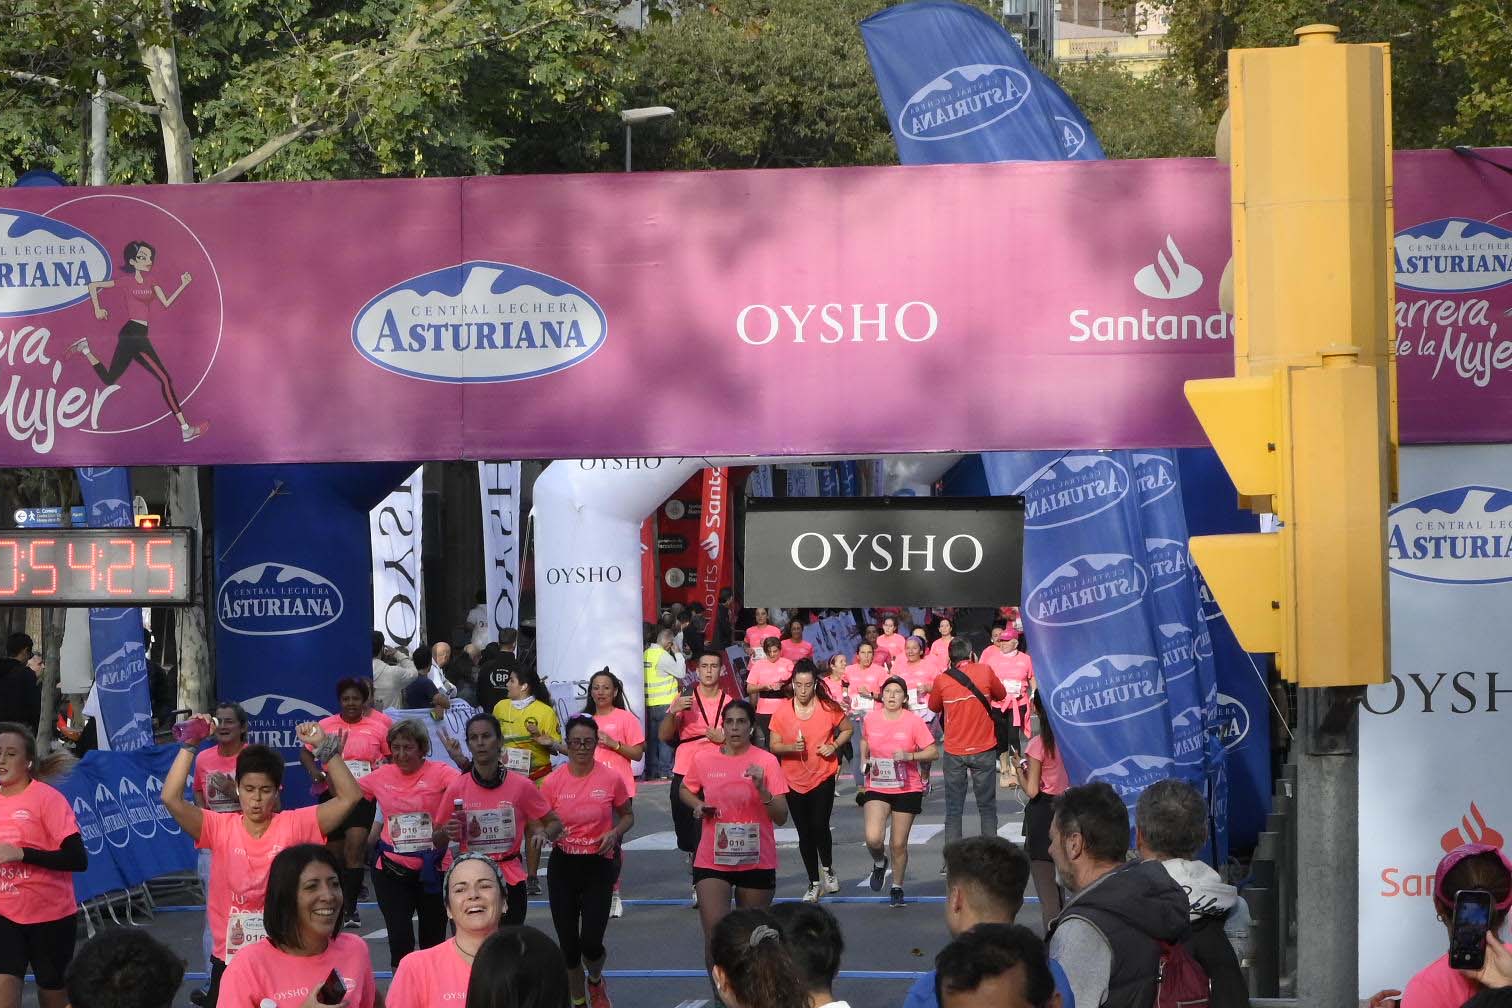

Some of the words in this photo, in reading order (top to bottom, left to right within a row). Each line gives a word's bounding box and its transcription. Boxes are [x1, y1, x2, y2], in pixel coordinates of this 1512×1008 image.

[15, 245, 87, 256] LECHERA
[1464, 242, 1512, 250] LECHER
[411, 304, 489, 317] CENTRAL
[497, 302, 579, 315] LECHERA
[1394, 299, 1490, 327] arrera
[371, 308, 587, 353] ASTURIANA
[735, 301, 938, 346] OYSHO
[1069, 309, 1235, 343] Santand
[1418, 328, 1436, 356] la
[1431, 322, 1512, 387] Muje
[1416, 520, 1483, 530] CENTRAL
[790, 532, 984, 574] OYSHO
[546, 566, 622, 584] OYSHO
[234, 588, 276, 596] CENTRAL
[281, 587, 330, 596] LECHERA
[221, 591, 335, 620] ASTURIANA
[1362, 671, 1512, 716] OYSH
[482, 826, 499, 834] 016
[274, 987, 309, 1001] OYSHO
